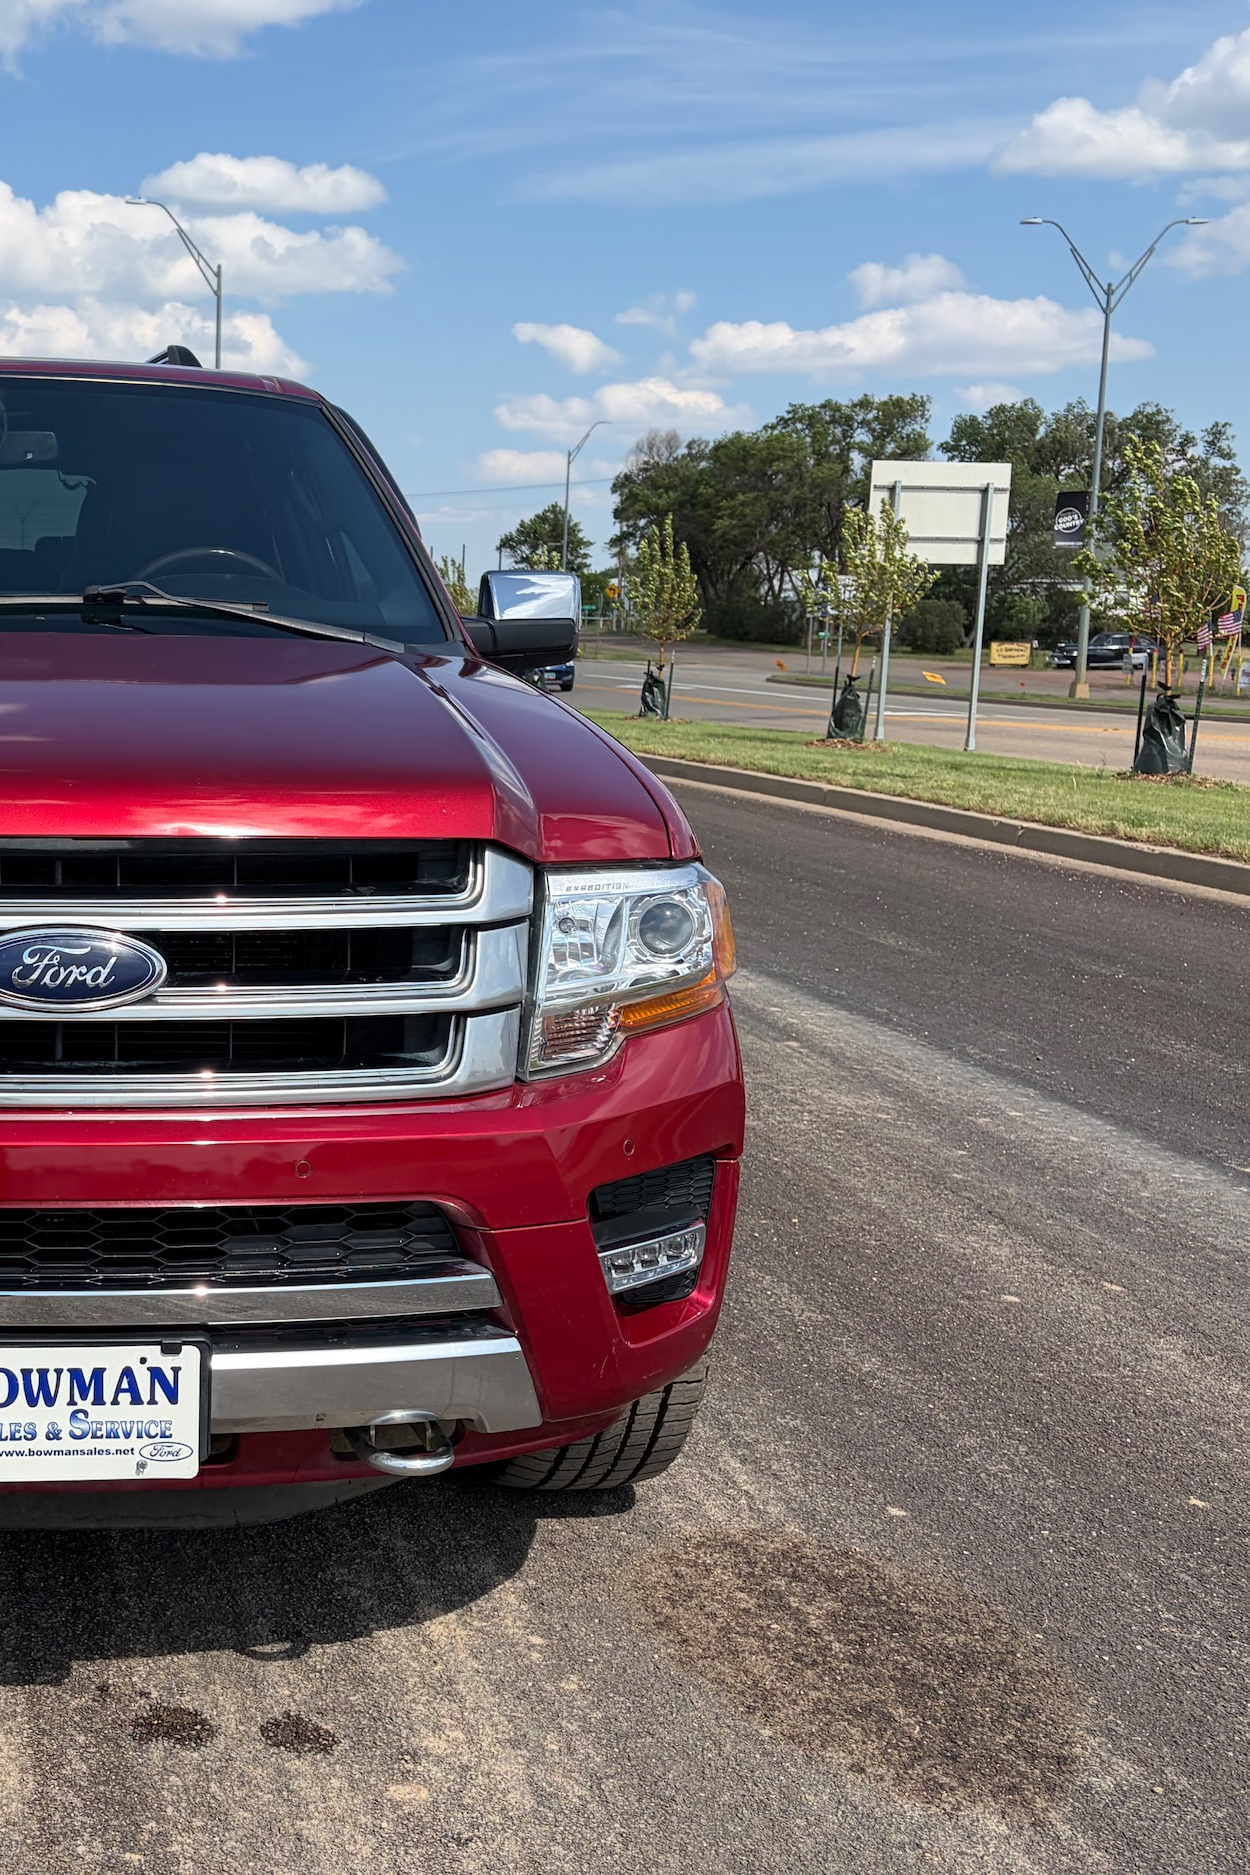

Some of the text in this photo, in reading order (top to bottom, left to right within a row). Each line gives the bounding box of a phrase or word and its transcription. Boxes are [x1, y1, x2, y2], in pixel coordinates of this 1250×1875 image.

[11, 944, 118, 990] Ford
[45, 1422, 63, 1441] &
[149, 1445, 182, 1459] Ford
